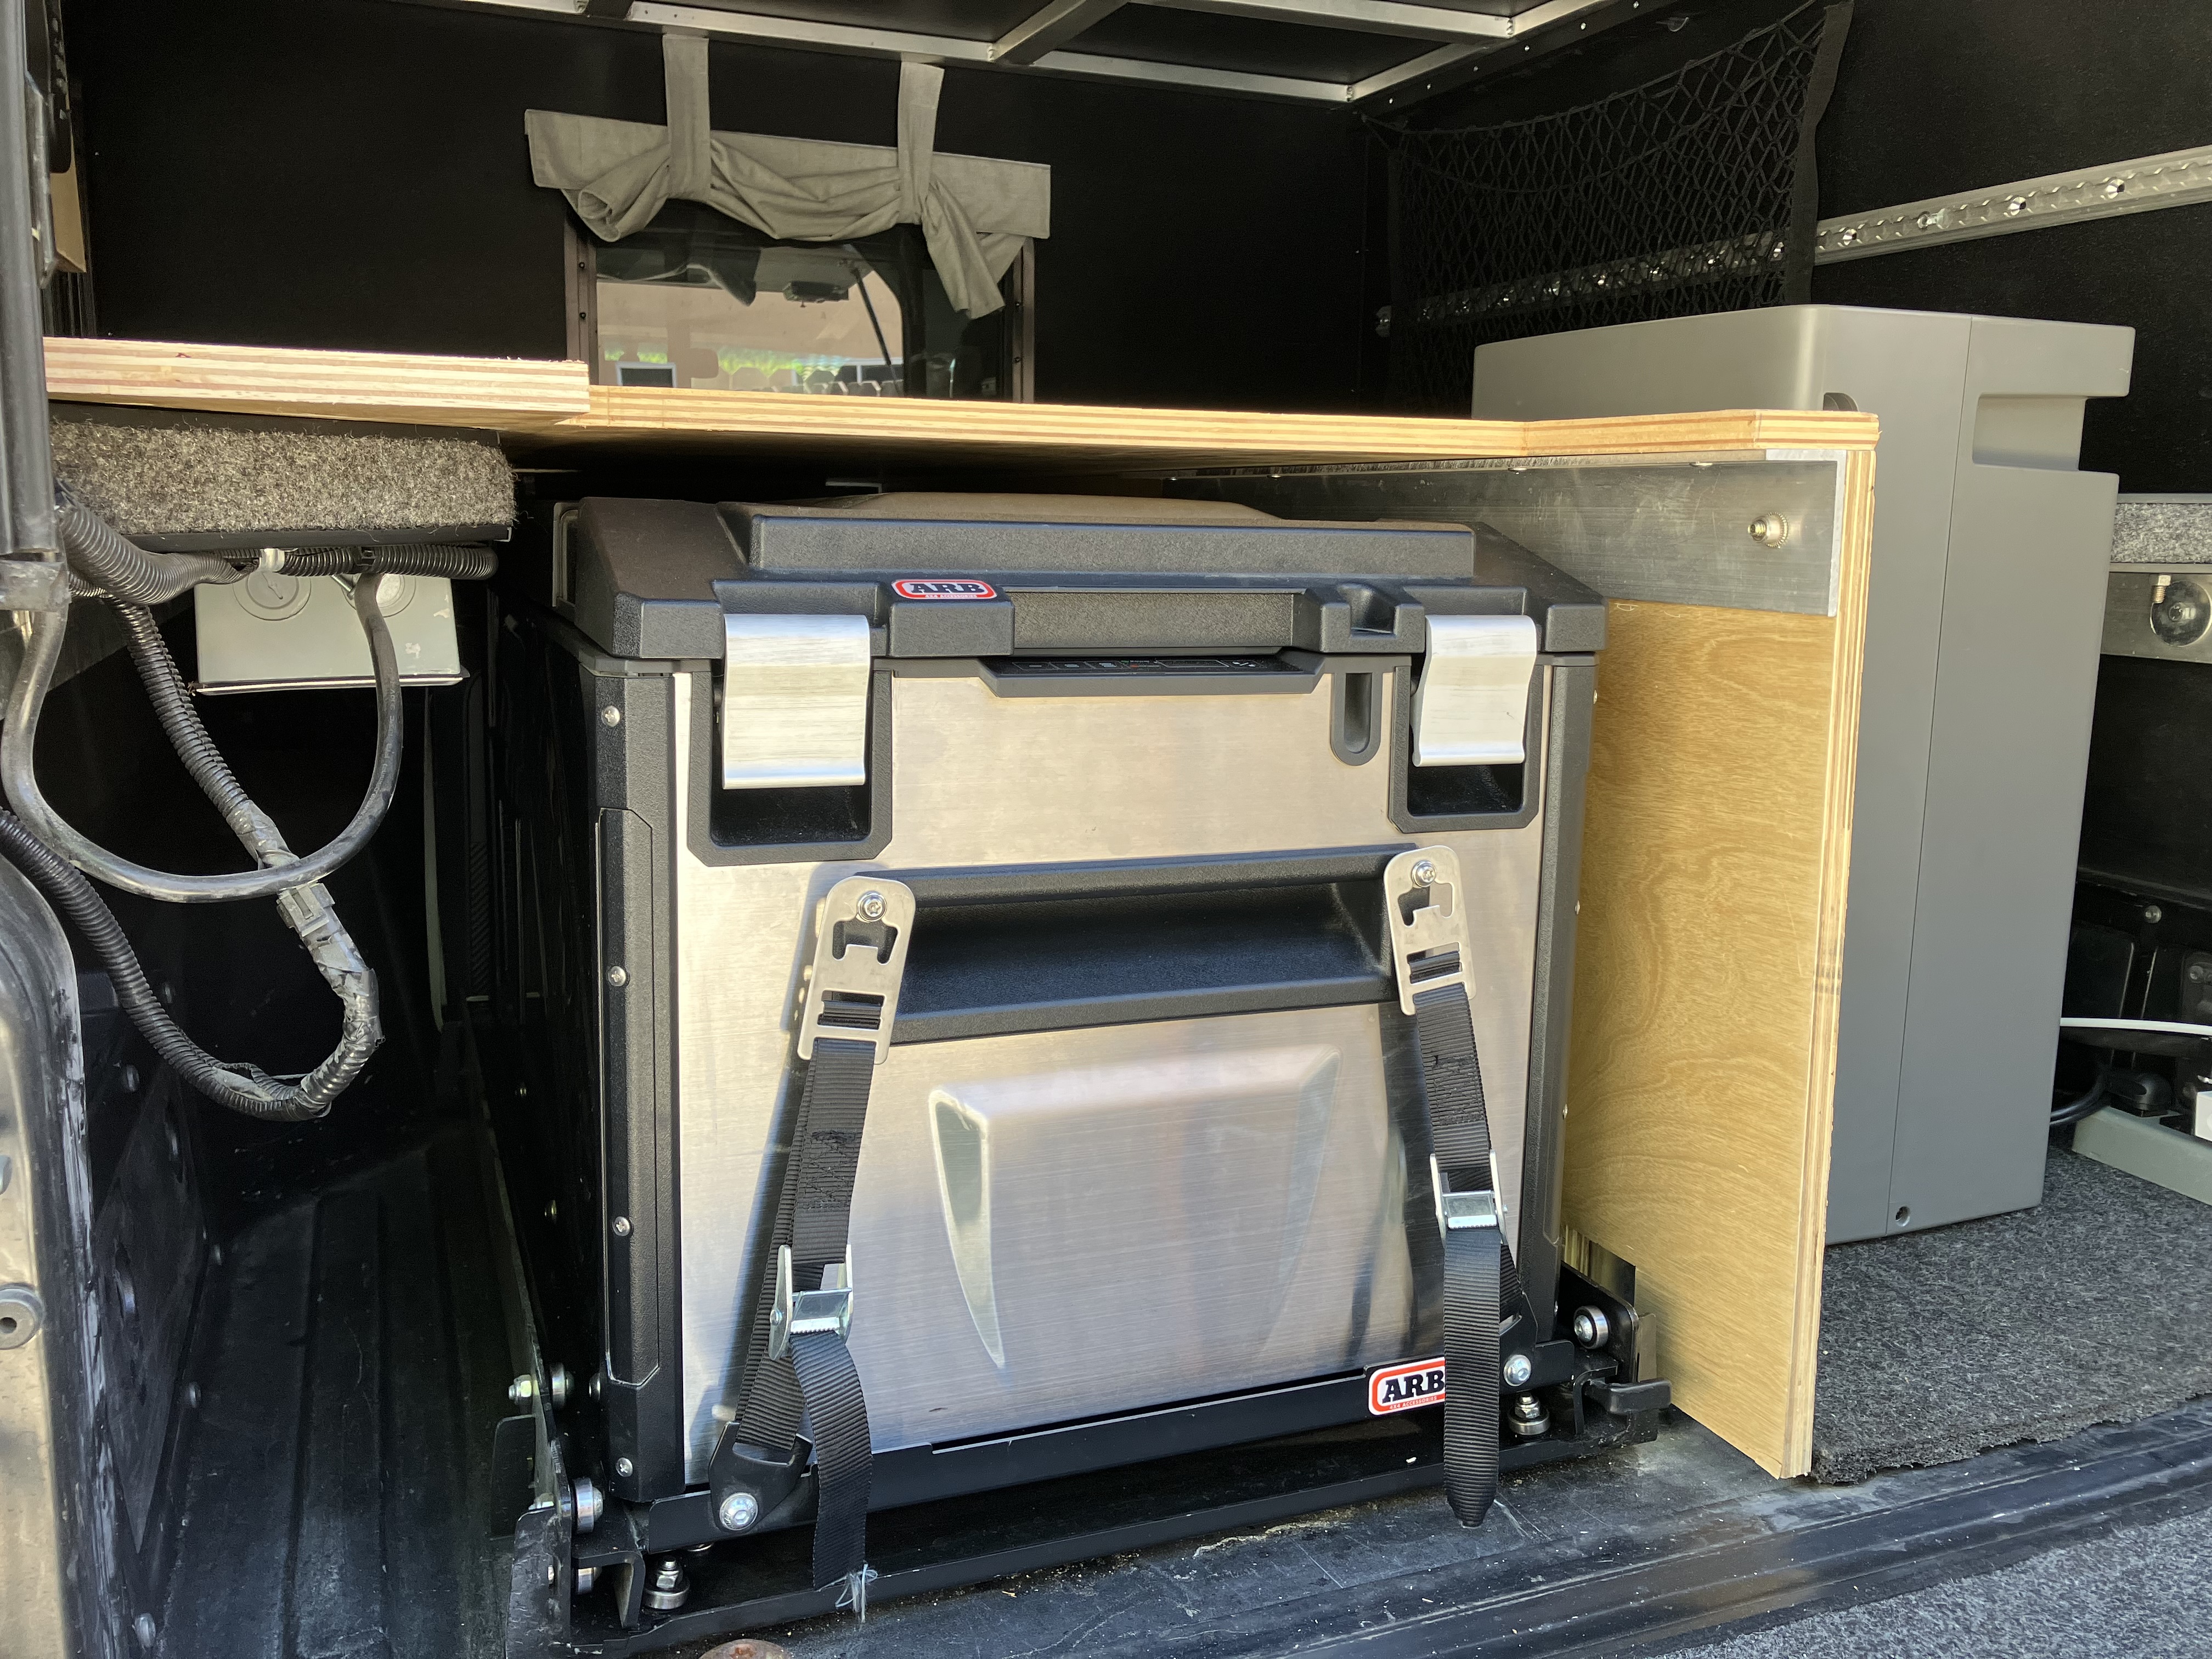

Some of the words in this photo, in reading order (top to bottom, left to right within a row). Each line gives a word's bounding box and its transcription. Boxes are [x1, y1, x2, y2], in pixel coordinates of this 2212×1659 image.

[909, 583, 985, 594] ARB
[1381, 1370, 1445, 1404] ARB
[1402, 1396, 1437, 1407] ACCESSORIES
